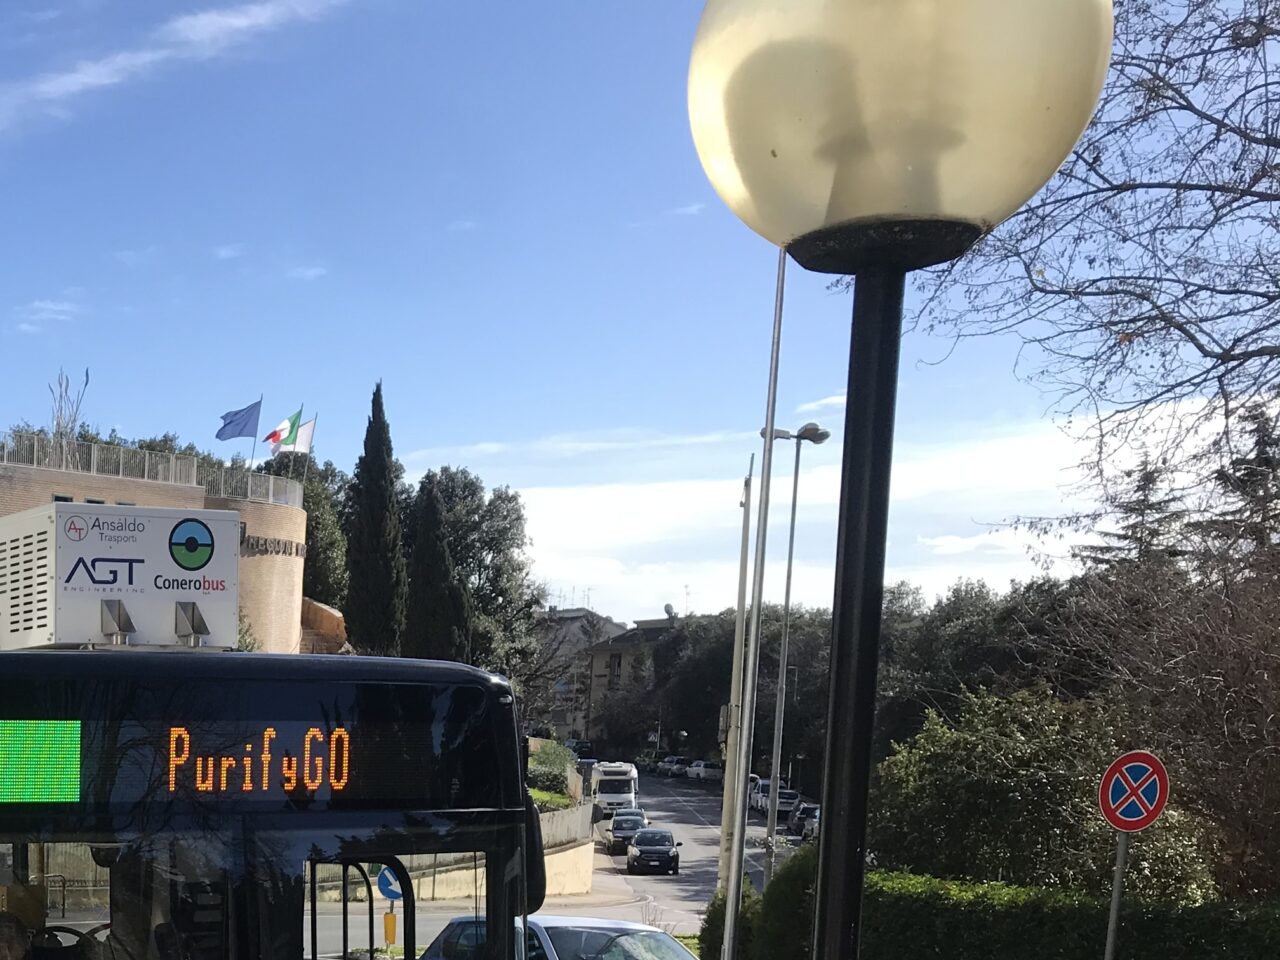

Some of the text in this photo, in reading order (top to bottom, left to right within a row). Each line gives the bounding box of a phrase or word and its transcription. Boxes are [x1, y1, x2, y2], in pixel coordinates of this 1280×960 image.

[91, 517, 145, 533] Ansaldo
[98, 532, 138, 544] Trasporti
[64, 556, 145, 585] AGT
[153, 574, 226, 592] Conerobus
[169, 727, 352, 792] PurifyGO
